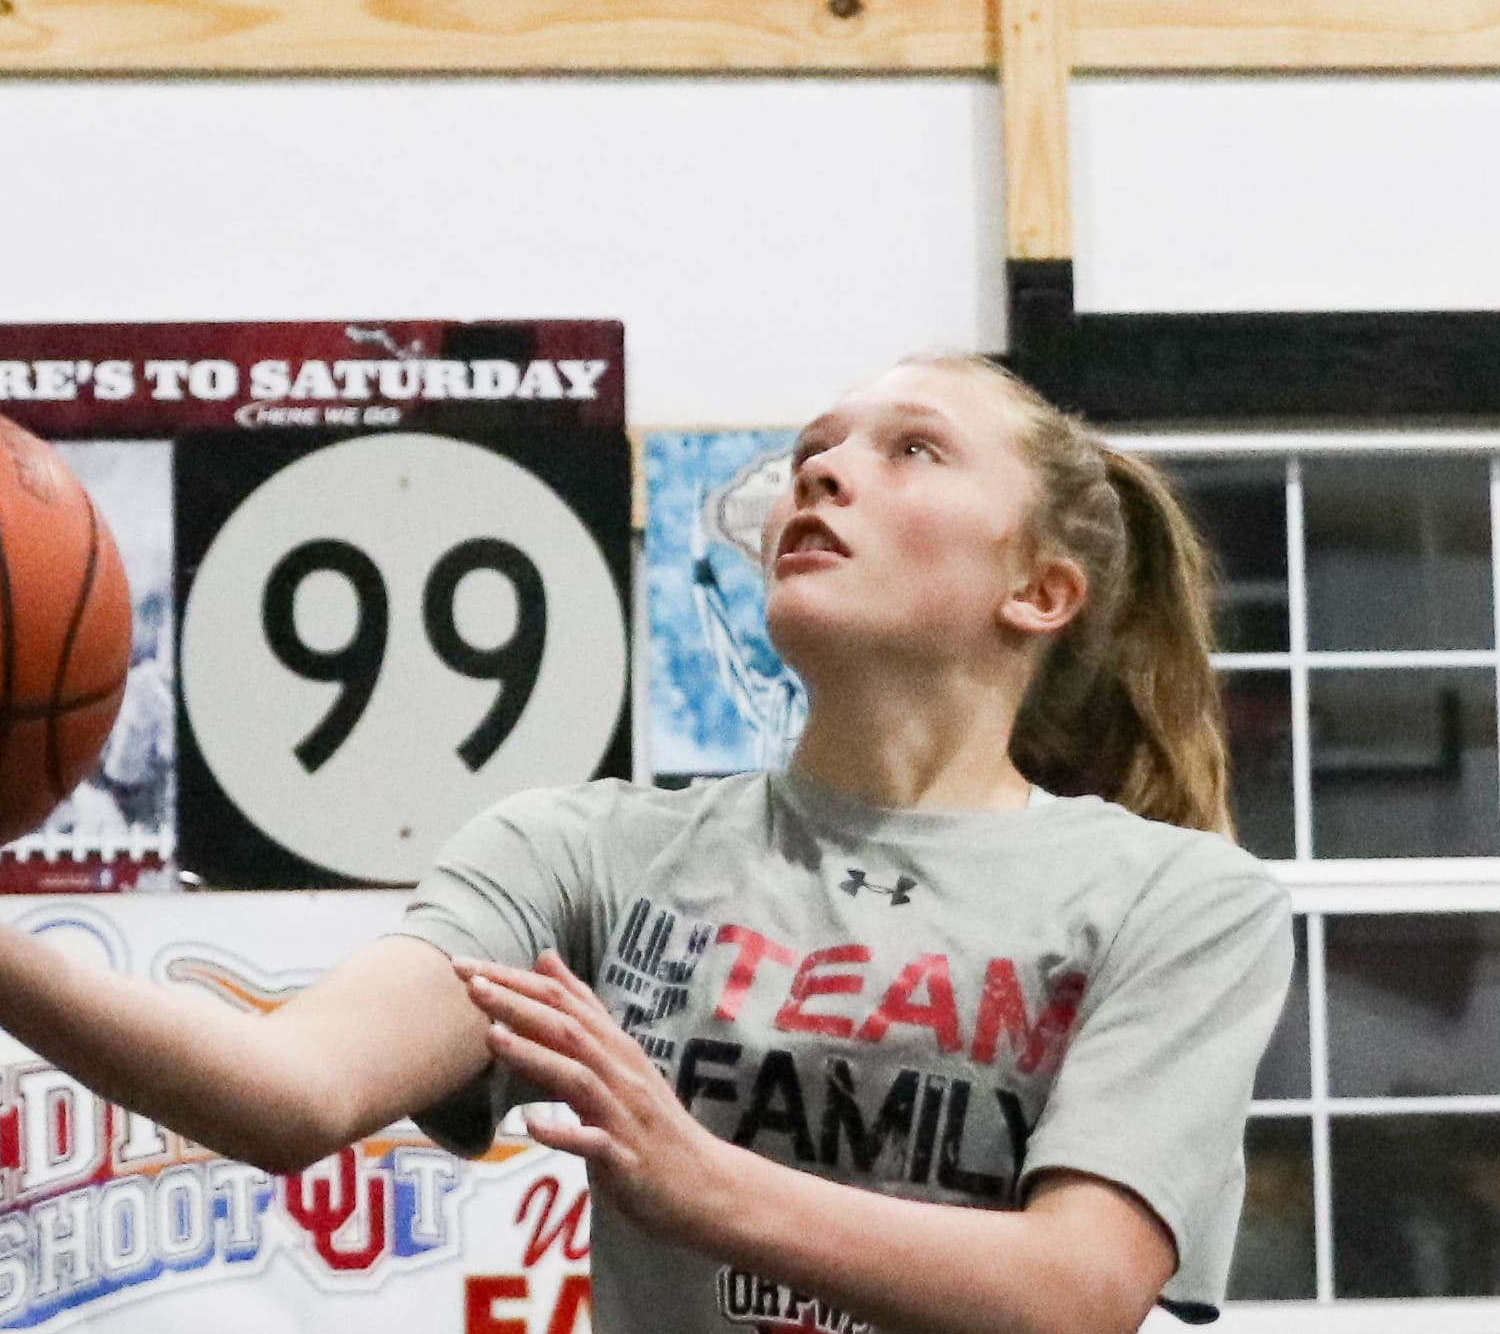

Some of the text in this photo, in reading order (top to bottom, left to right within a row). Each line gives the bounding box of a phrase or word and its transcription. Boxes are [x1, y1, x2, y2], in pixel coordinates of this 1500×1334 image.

[143, 358, 238, 401] TO
[249, 358, 607, 401] SATURDAY
[260, 535, 548, 774] 99
[713, 923, 1089, 1076] TEAM
